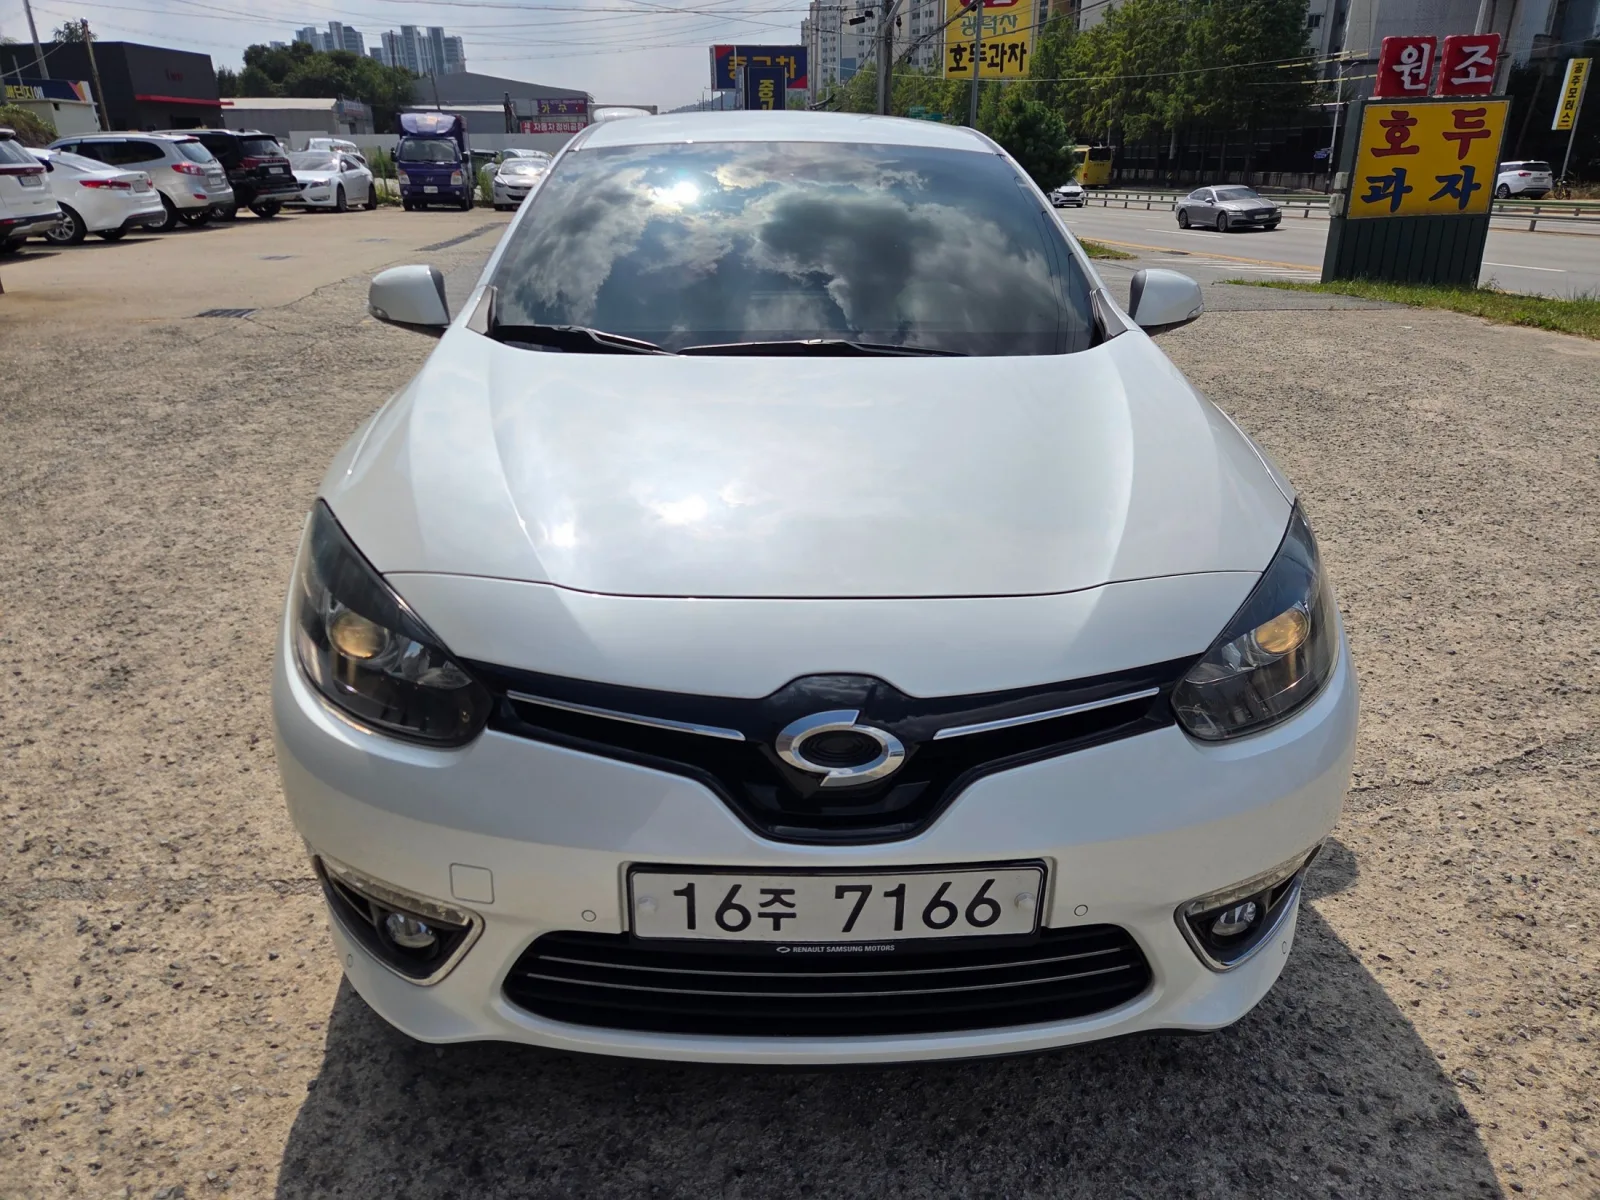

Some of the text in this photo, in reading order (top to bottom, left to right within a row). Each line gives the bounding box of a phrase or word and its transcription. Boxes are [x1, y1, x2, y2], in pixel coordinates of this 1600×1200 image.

[948, 41, 1027, 73] 호두과자
[1392, 43, 1493, 90] 원조
[1370, 107, 1492, 161] 호두
[1360, 165, 1482, 213] 과자
[672, 878, 1002, 933] 16주 7166
[792, 944, 895, 954] RENAULT SAMSUNG MOTORS
